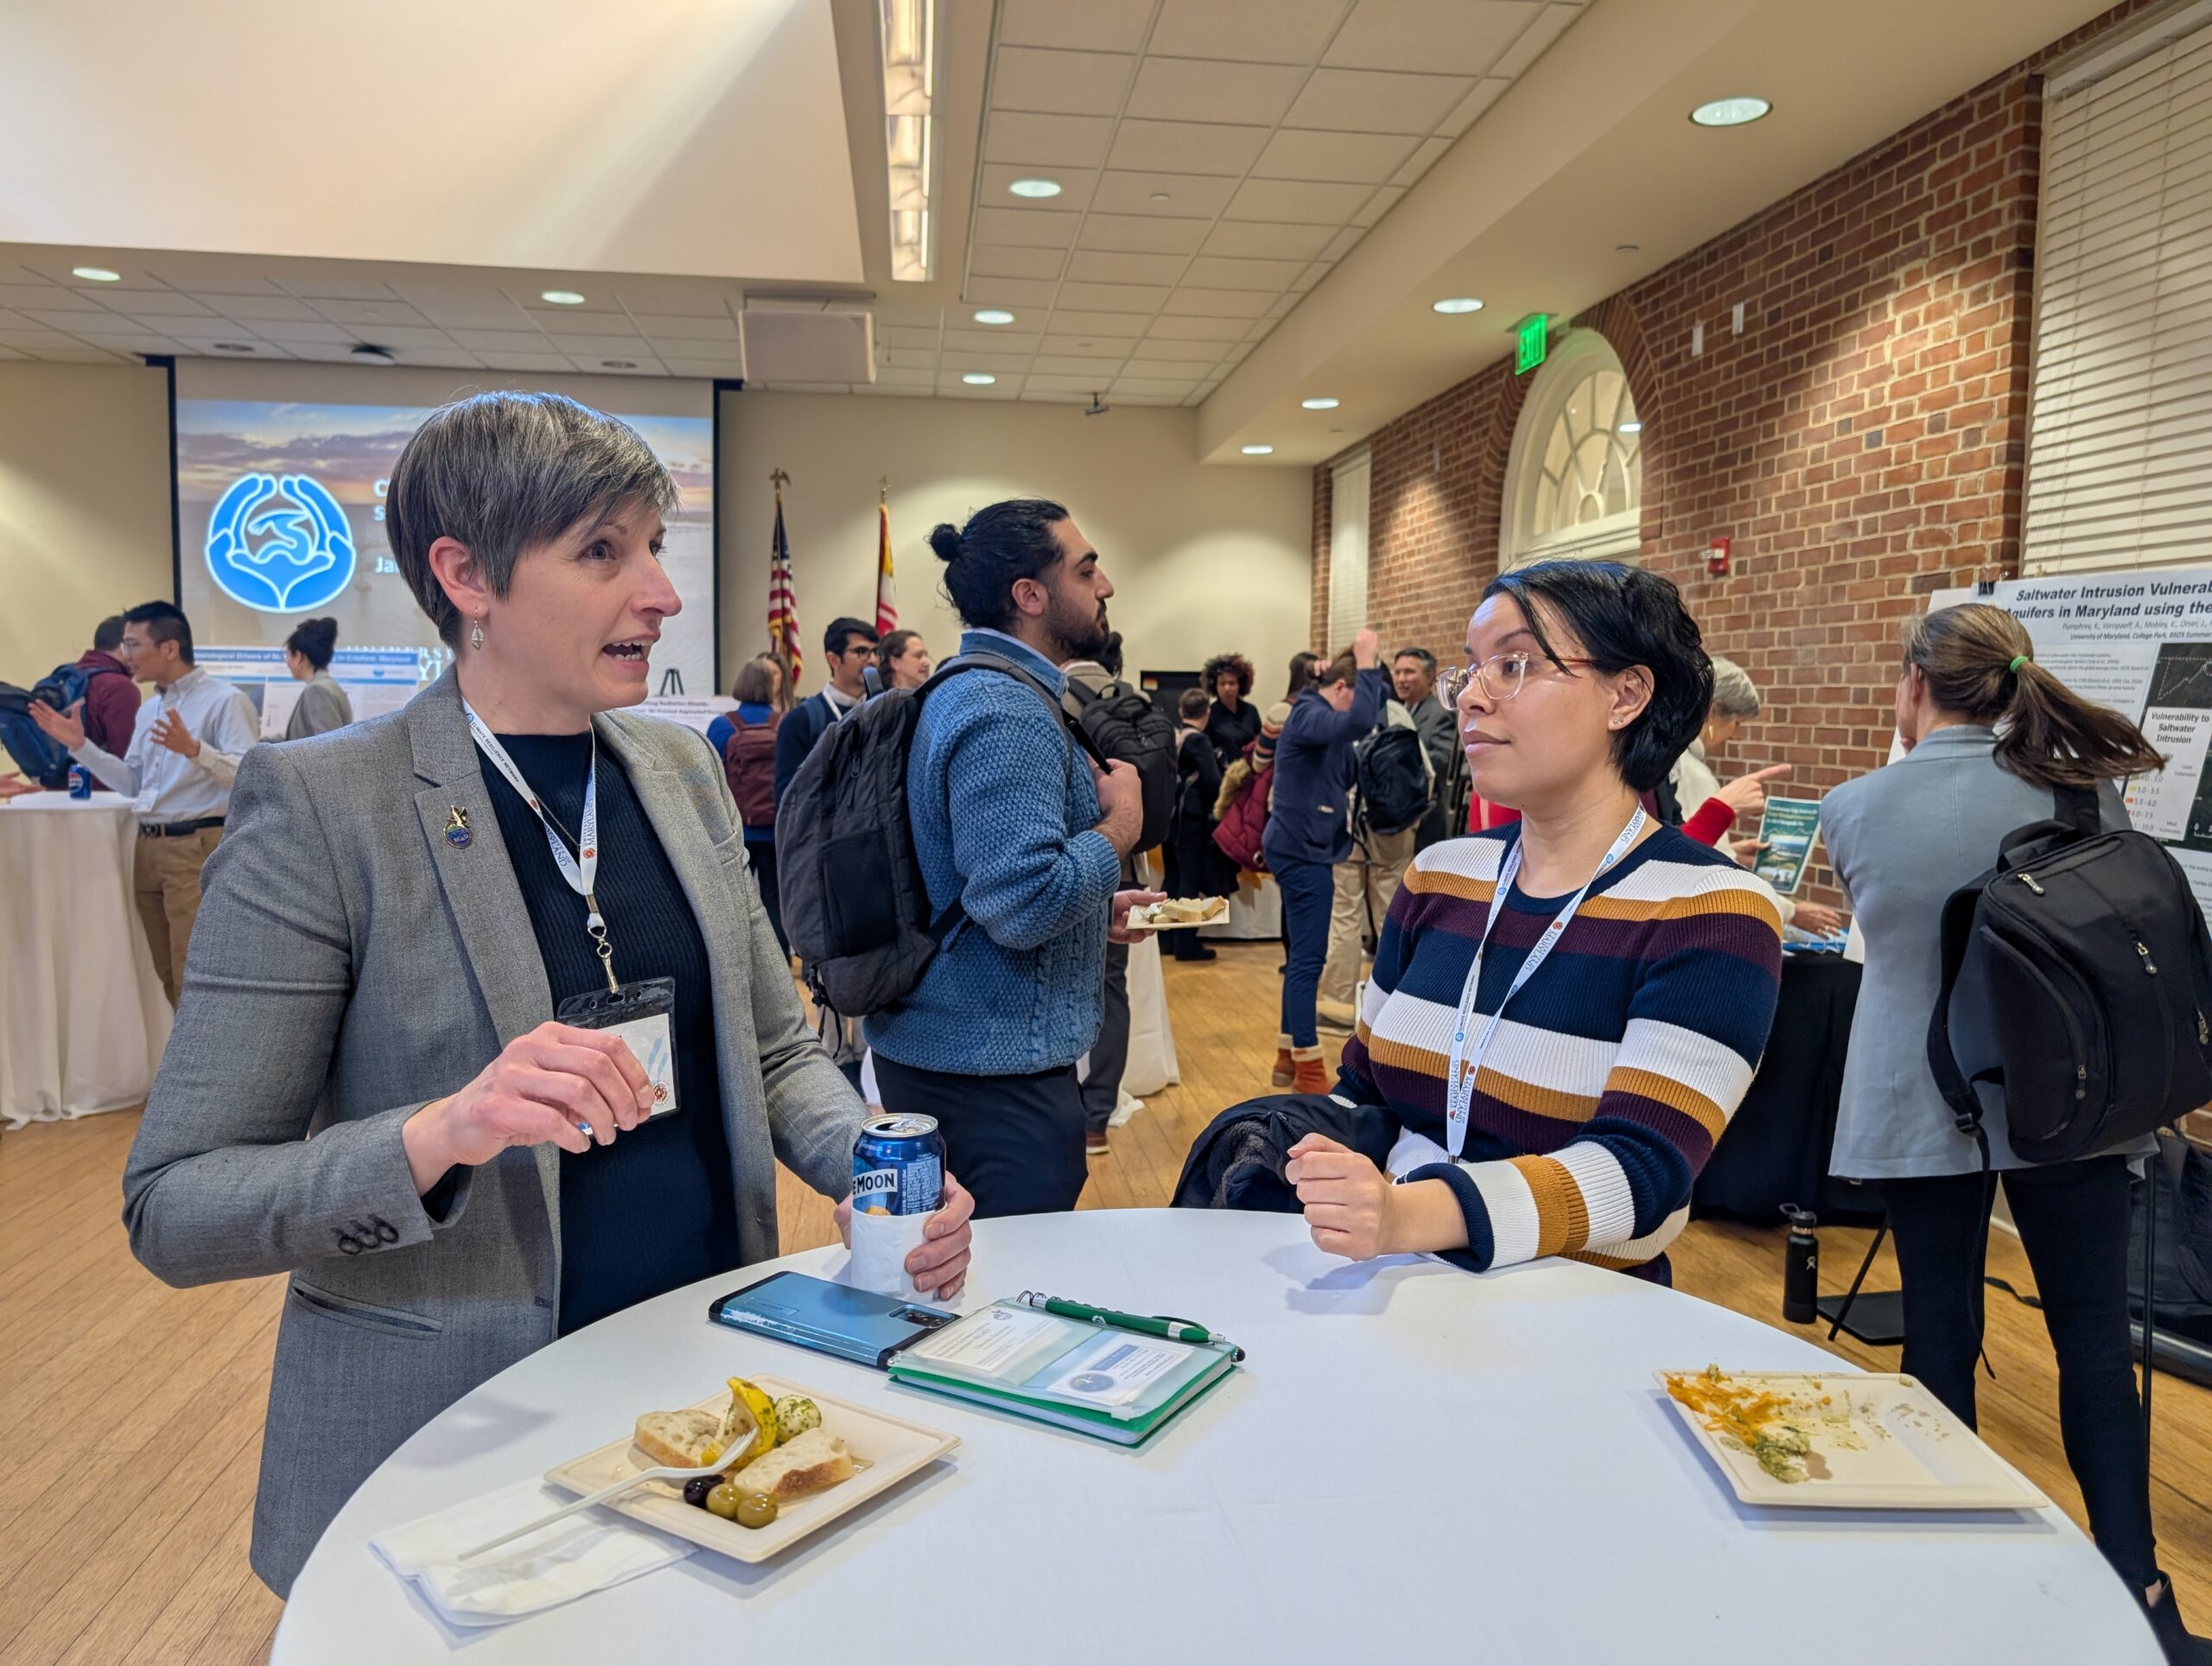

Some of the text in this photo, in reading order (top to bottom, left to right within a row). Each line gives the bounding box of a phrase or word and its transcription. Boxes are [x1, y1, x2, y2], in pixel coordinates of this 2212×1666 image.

[2016, 588, 2077, 601] Saltwater
[2081, 584, 2145, 598] Intrusion
[2058, 605, 2071, 618] in
[2075, 603, 2141, 620] Maryland
[2144, 601, 2185, 618] using
[2189, 601, 2212, 614] the
[2151, 711, 2199, 724] Vulnerability
[2158, 723, 2196, 734] Saltwater
[2156, 734, 2191, 745] Intrusion
[472, 722, 486, 741] CLIMATE
[485, 738, 505, 763] RESILIENCE
[504, 761, 519, 783] NETWORK
[1524, 929, 1555, 970] MARYLAND
[1455, 1077, 1471, 1123] MARYLAND
[857, 1172, 895, 1193] MOON
